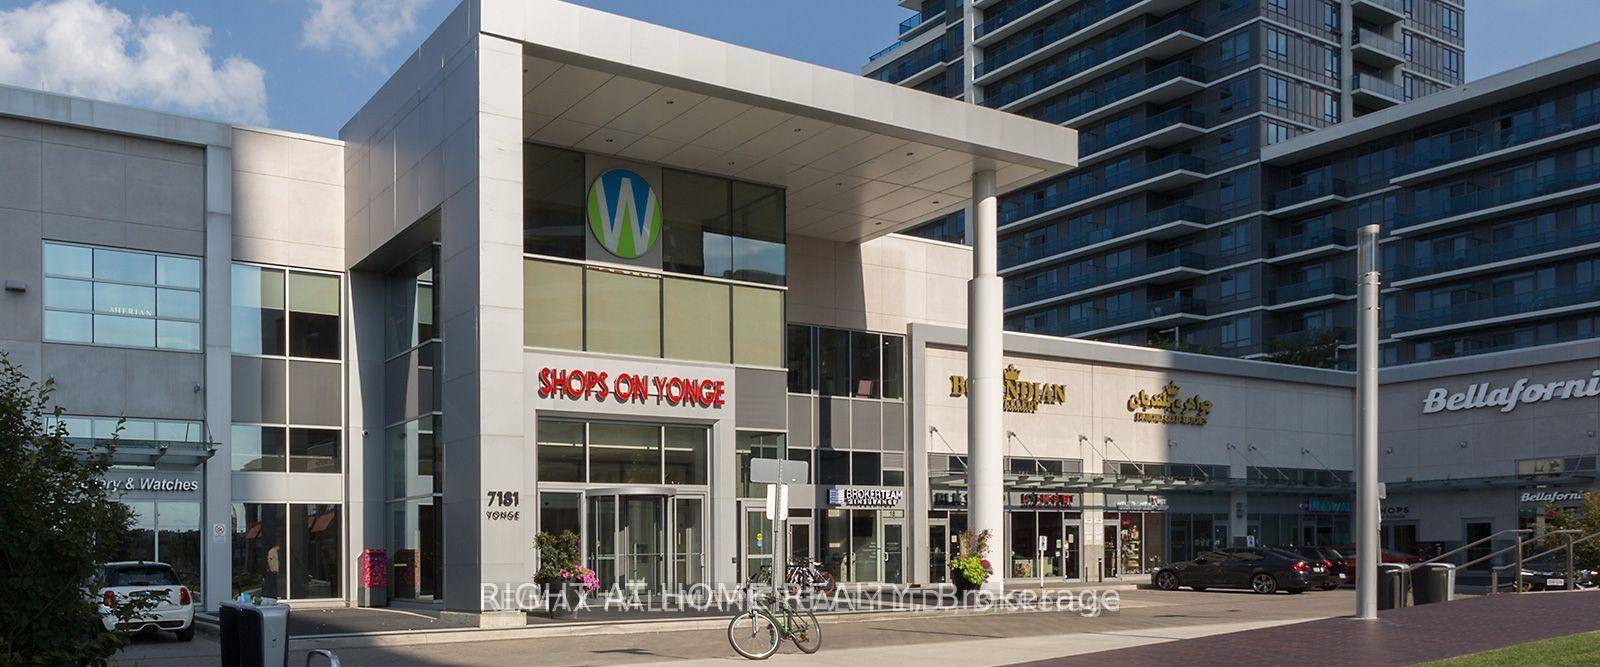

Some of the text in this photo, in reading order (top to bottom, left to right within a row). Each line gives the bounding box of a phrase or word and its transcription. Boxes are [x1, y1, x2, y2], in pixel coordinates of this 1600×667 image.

[593, 176, 656, 256] W
[539, 367, 726, 408] SHOPS ON YONGE
[949, 375, 1067, 406] BNDIAN
[125, 477, 135, 490] &
[140, 478, 198, 491] Watches
[487, 491, 519, 507] 7181
[846, 489, 903, 501] BROKERTEAM
[486, 511, 520, 521] YONGE
